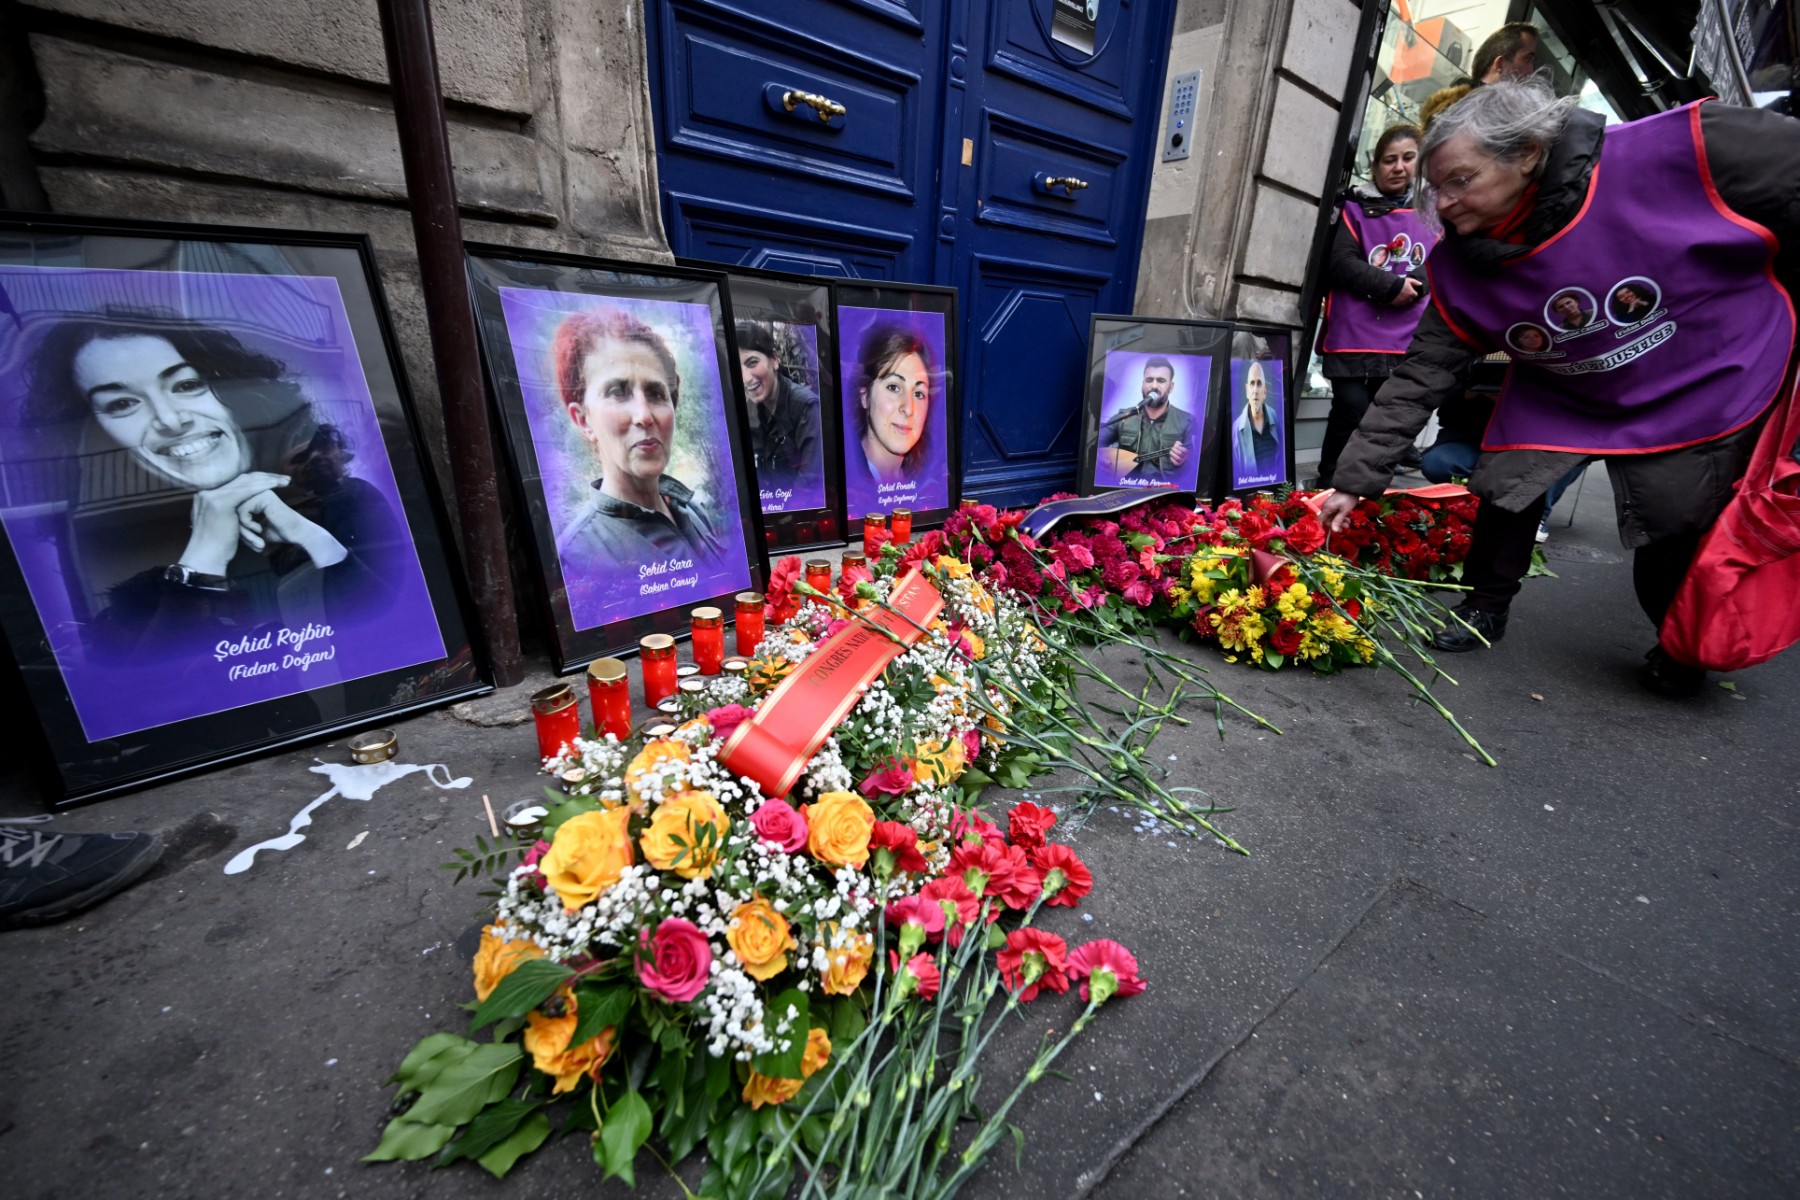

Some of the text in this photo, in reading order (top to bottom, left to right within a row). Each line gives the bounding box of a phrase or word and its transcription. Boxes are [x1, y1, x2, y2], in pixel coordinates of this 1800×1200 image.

[1605, 324, 1673, 368] JUSTICE
[638, 558, 694, 580] Şehid Sara
[213, 622, 335, 662] Şehid Rojbîn
[228, 645, 336, 682] (Fidan Doğan)
